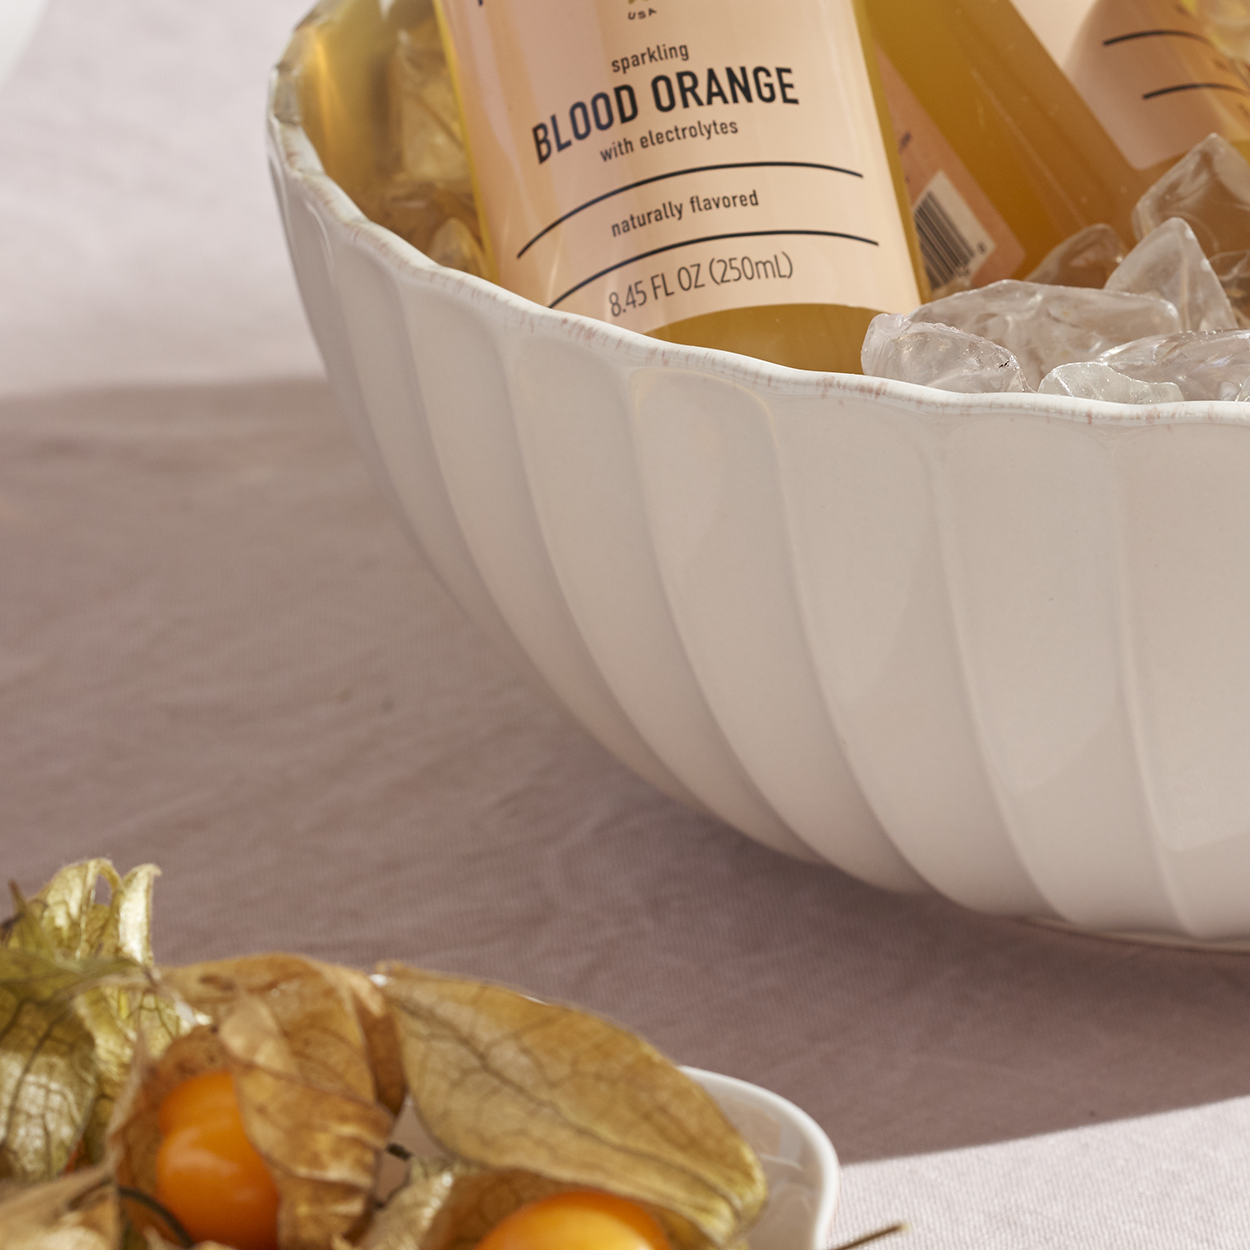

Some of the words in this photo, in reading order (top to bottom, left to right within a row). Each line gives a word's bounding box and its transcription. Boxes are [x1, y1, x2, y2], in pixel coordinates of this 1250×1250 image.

[627, 7, 657, 21] USA
[611, 43, 690, 74] sparkling
[531, 84, 639, 165] BLOOD
[650, 65, 800, 113] ORANGE
[599, 136, 635, 163] with
[639, 119, 739, 150] electrolytes
[611, 201, 684, 238] naturally
[689, 189, 760, 214] flavored
[608, 281, 648, 317] 8.45
[650, 272, 675, 300] FL
[676, 263, 706, 292] OZ
[708, 251, 794, 286] (250mL)
